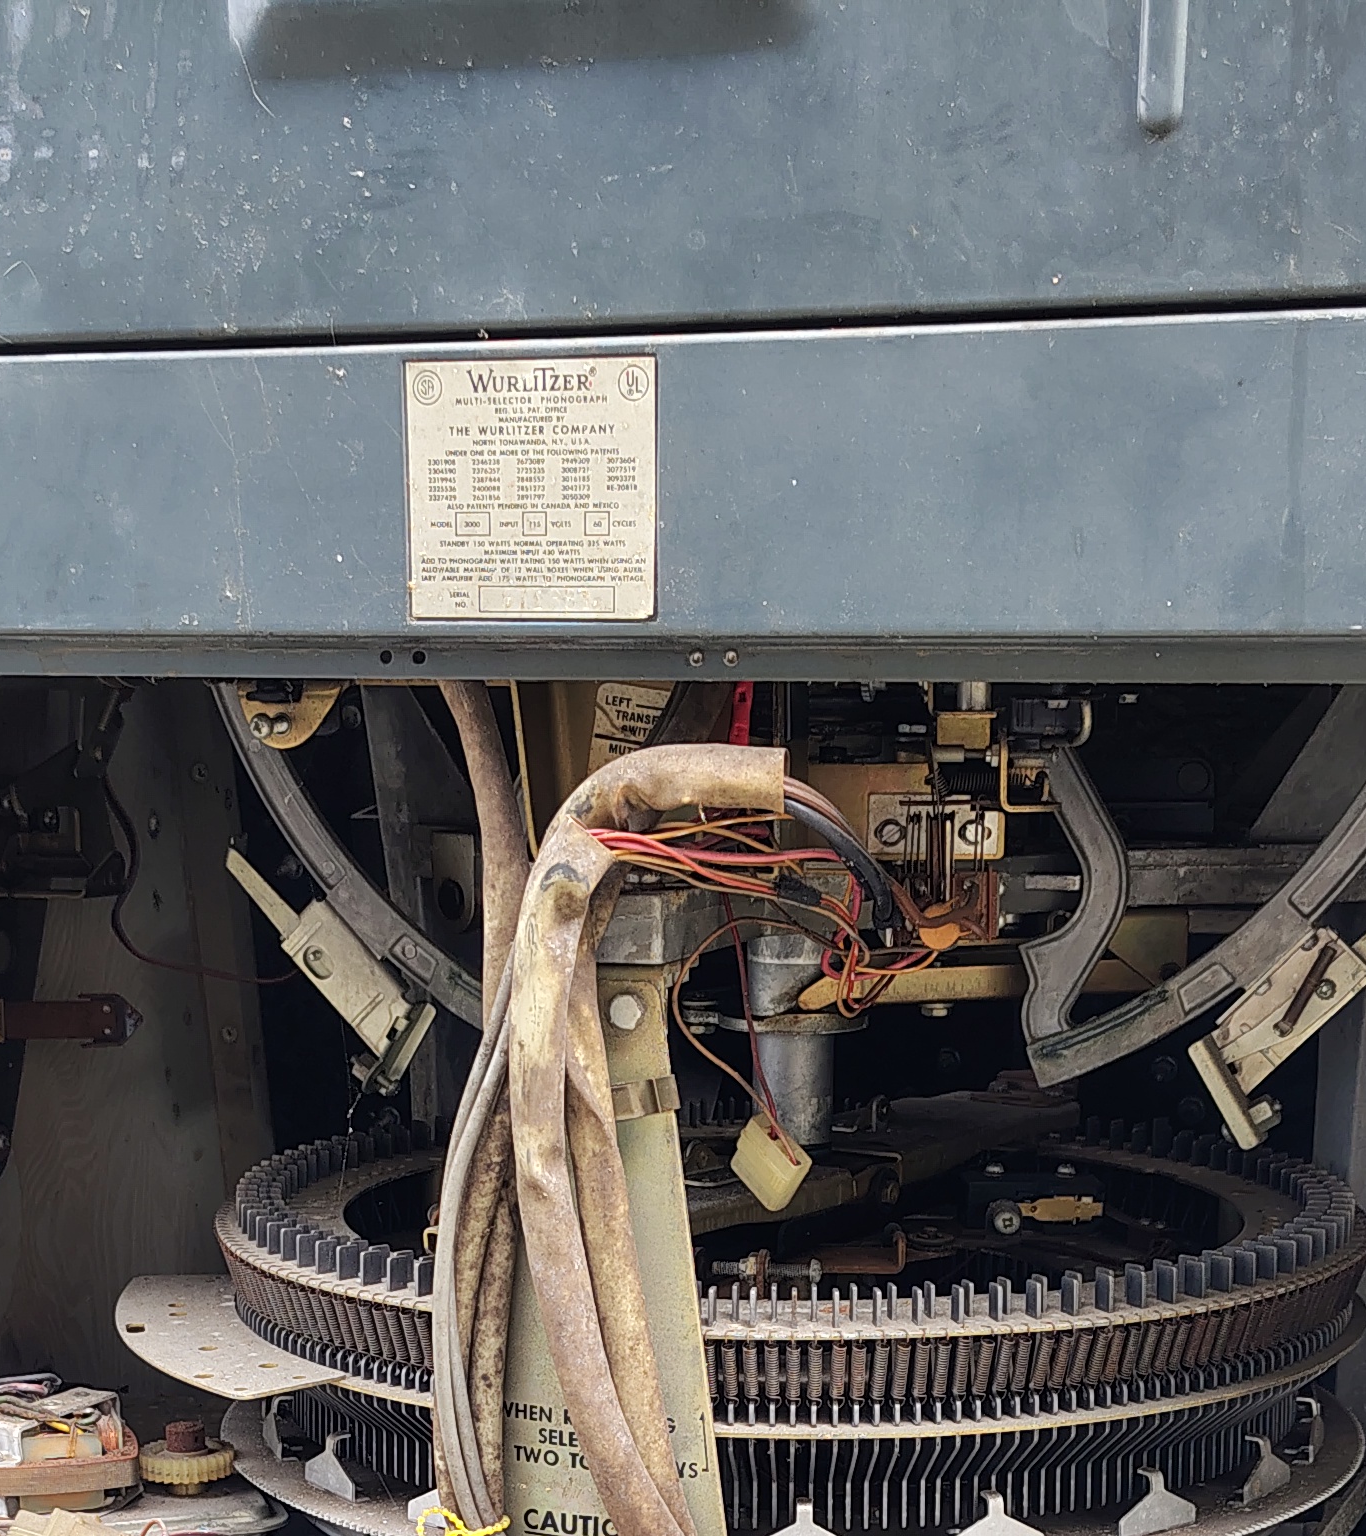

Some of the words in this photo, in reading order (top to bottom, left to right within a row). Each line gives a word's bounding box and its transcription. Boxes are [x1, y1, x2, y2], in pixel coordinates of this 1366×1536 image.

[455, 397, 532, 406] MULTI-SELECTOR
[541, 395, 608, 404] PHONOGRAPH
[545, 406, 567, 414] OFFICE
[449, 426, 471, 436] THE
[478, 425, 545, 436] WURLITZER
[553, 424, 615, 435] COMPANY
[547, 448, 588, 456] FOLLOWING
[591, 448, 619, 456] PATENTS
[551, 520, 571, 528] VOLTS
[612, 520, 637, 528] CYCLES
[439, 540, 469, 548] STANDBY
[597, 566, 619, 574] USING
[605, 694, 632, 708] LEFT
[615, 710, 660, 725] TRANSF
[609, 744, 634, 756] MUT
[514, 1445, 559, 1466] TWO
